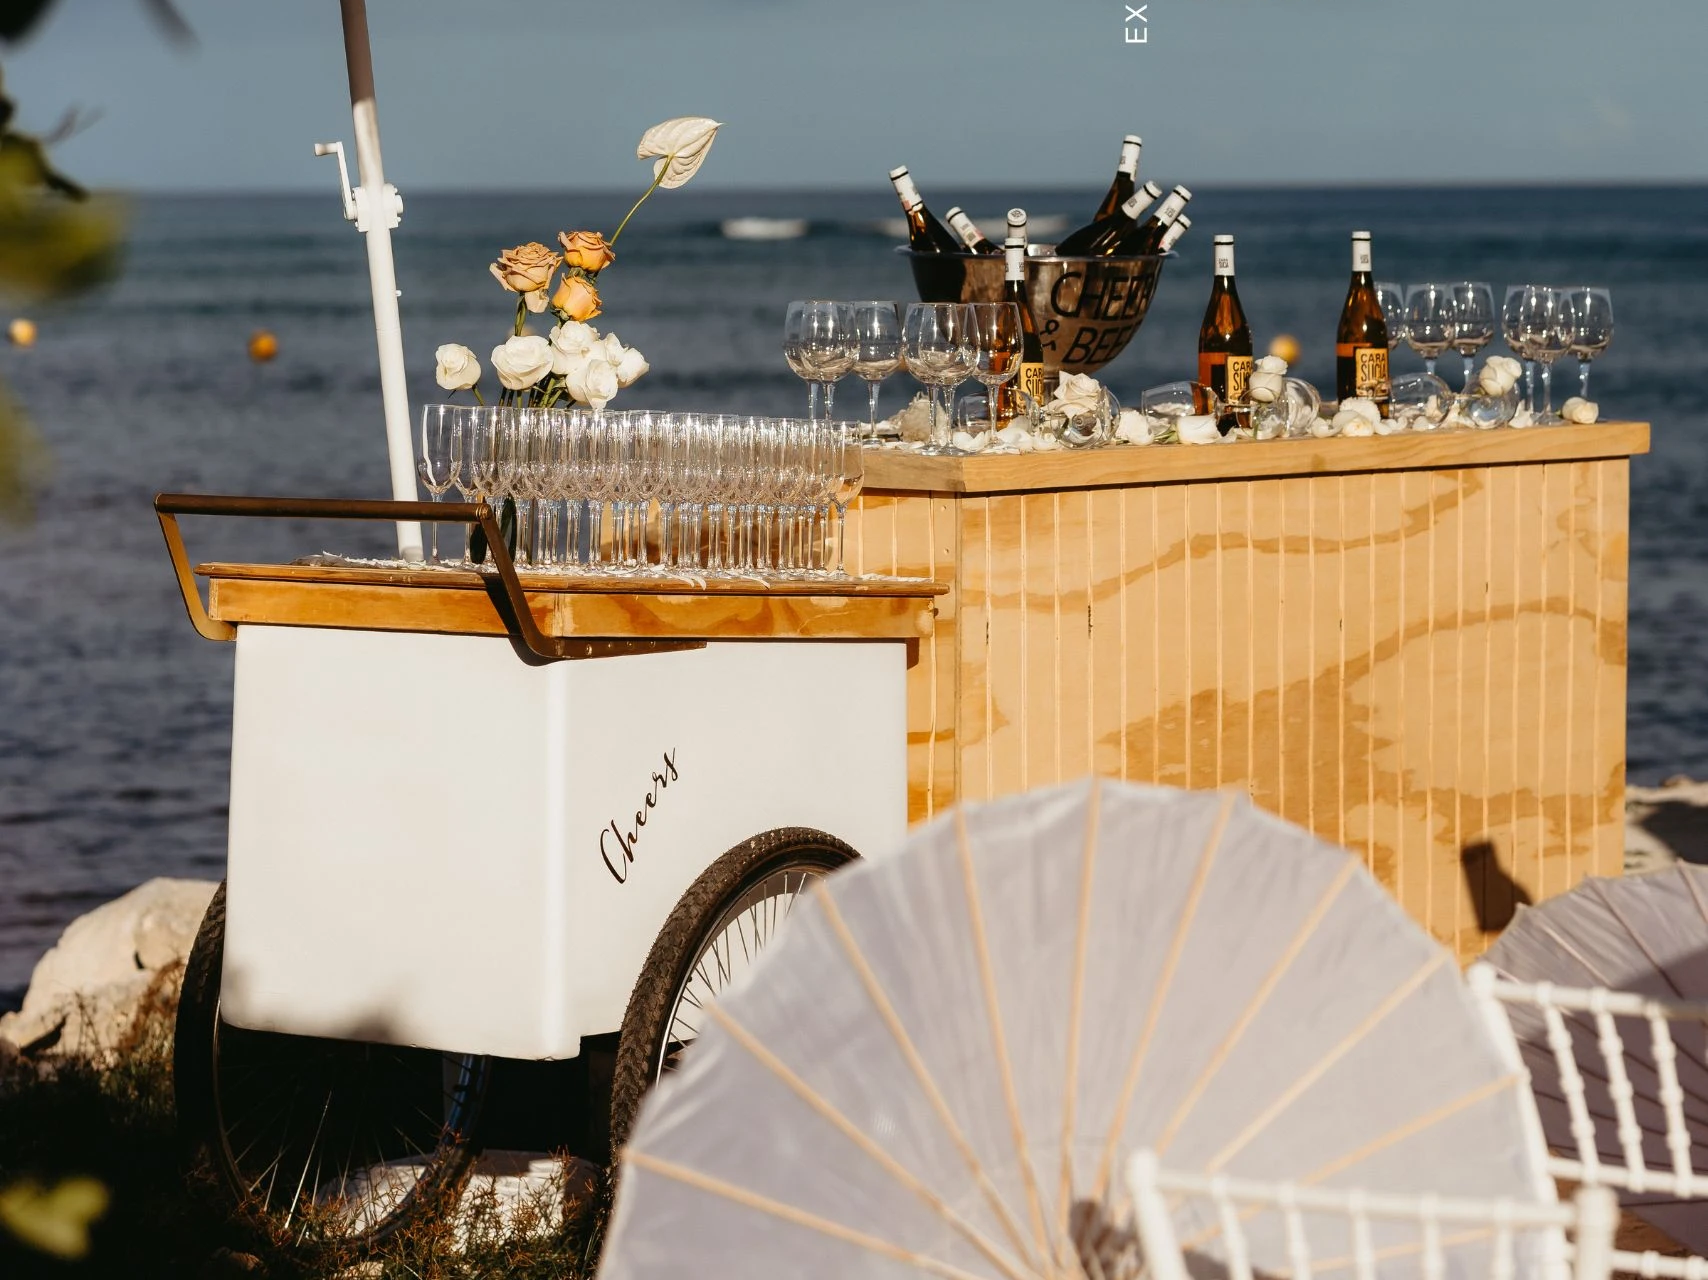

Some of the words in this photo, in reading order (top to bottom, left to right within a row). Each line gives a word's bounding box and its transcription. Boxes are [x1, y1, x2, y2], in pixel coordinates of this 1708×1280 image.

[1360, 353, 1386, 364] CARA
[1232, 361, 1253, 372] CAR
[599, 746, 679, 885] Cheers
